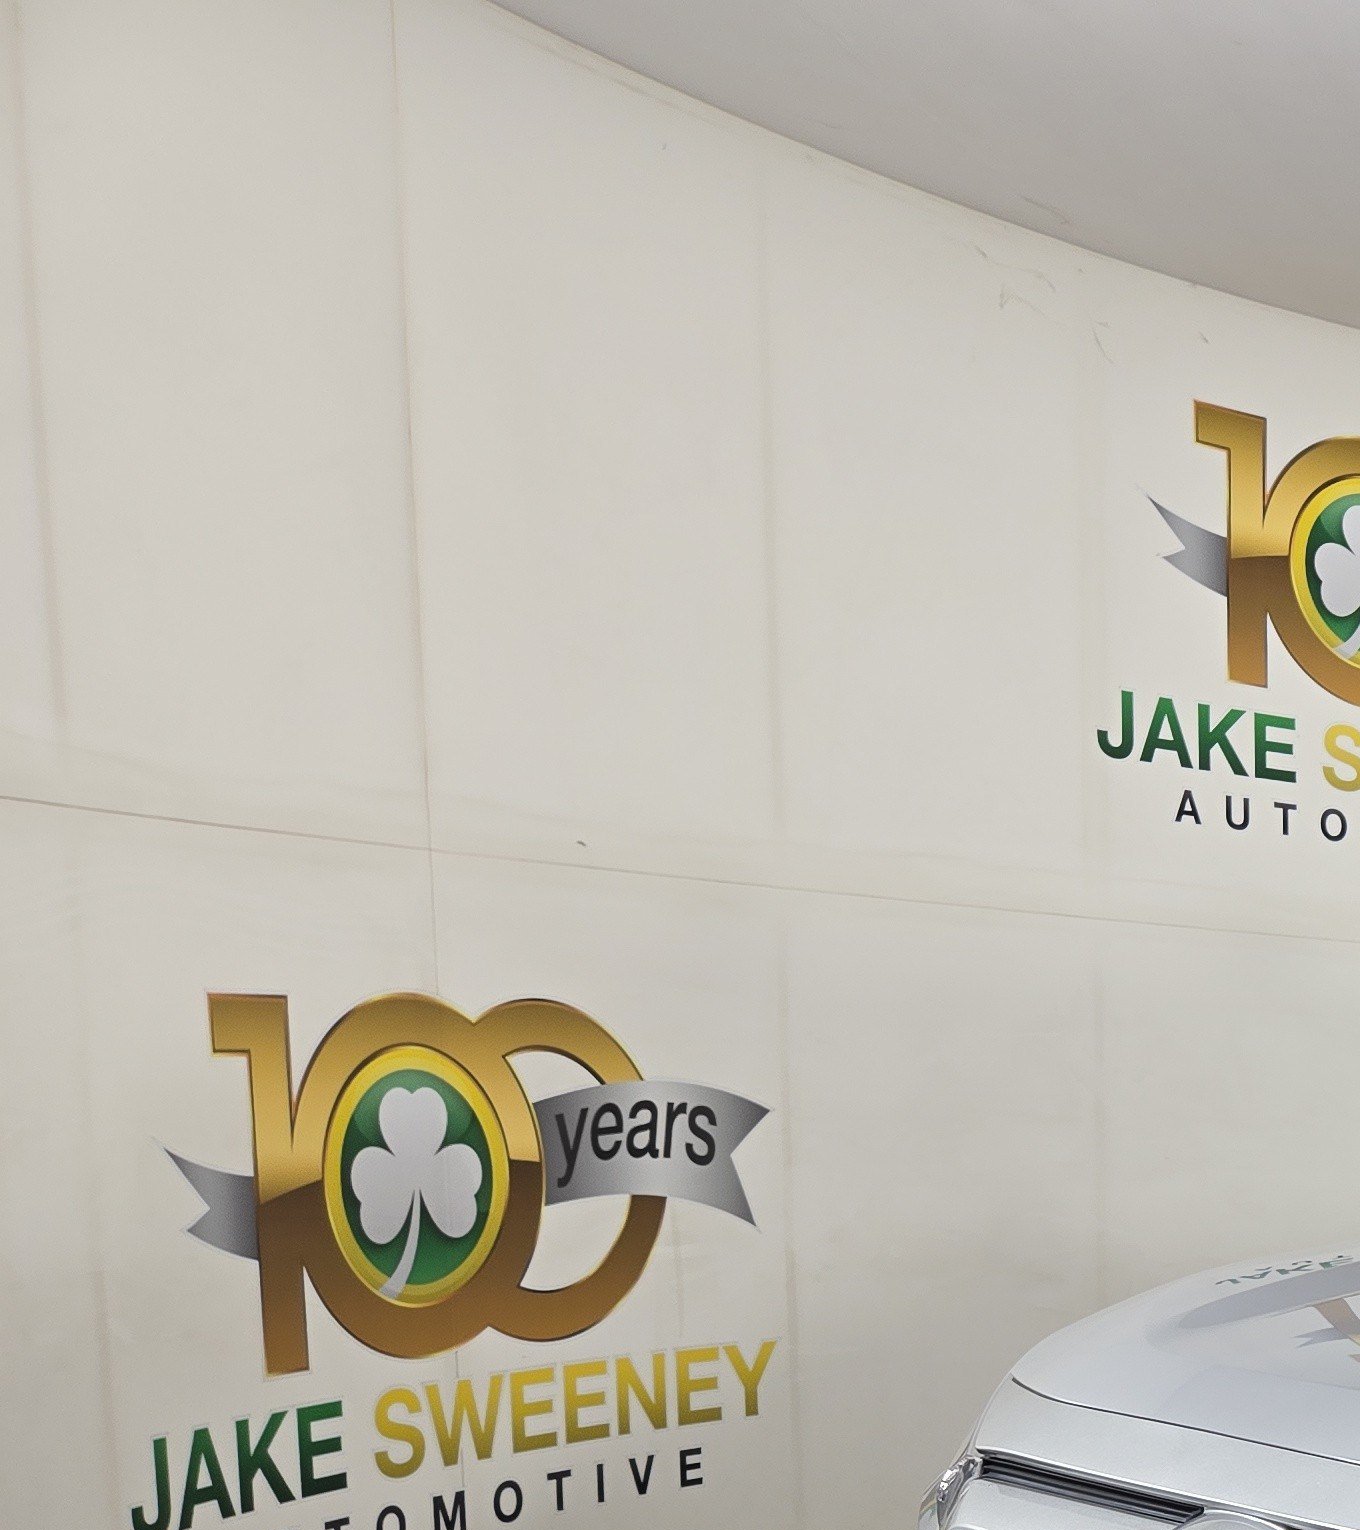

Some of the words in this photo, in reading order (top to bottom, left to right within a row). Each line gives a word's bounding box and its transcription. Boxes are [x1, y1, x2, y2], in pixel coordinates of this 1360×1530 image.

[1097, 690, 1296, 783] JAKE
[555, 1100, 718, 1189] years
[374, 1341, 776, 1479] SWEENEY
